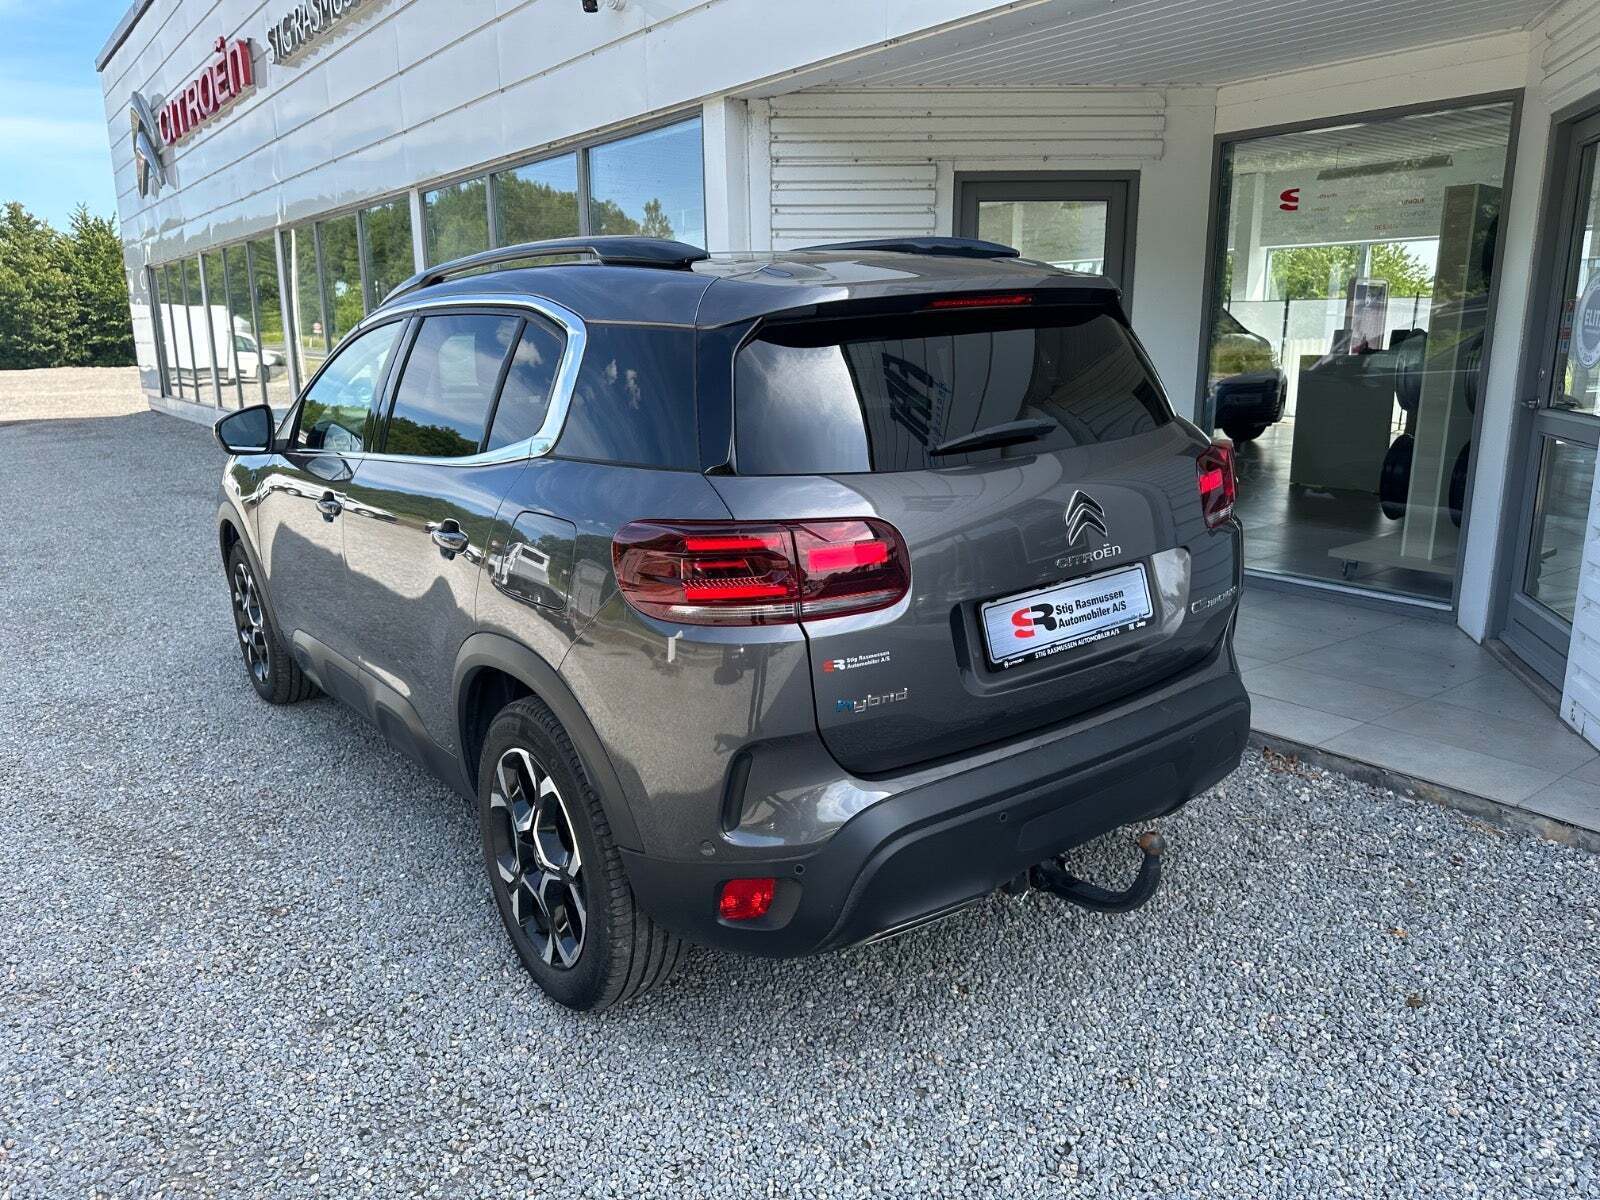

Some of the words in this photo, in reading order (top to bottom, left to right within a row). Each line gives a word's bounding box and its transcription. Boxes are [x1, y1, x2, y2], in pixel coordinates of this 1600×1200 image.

[265, 17, 293, 64] STIG
[1584, 308, 1600, 328] ELIT
[1055, 604, 1074, 616] Stig
[1075, 589, 1124, 609] Rasmussen
[1058, 608, 1111, 629] Automobiler
[1112, 600, 1127, 613] A/S
[858, 650, 890, 661] Rasmussen
[1034, 650, 1047, 660] STIG
[1047, 641, 1078, 656] RASMUSSEN
[1078, 631, 1111, 647] AUTOMOBILER
[1111, 628, 1120, 637] A/S
[847, 659, 880, 669] Automobiler
